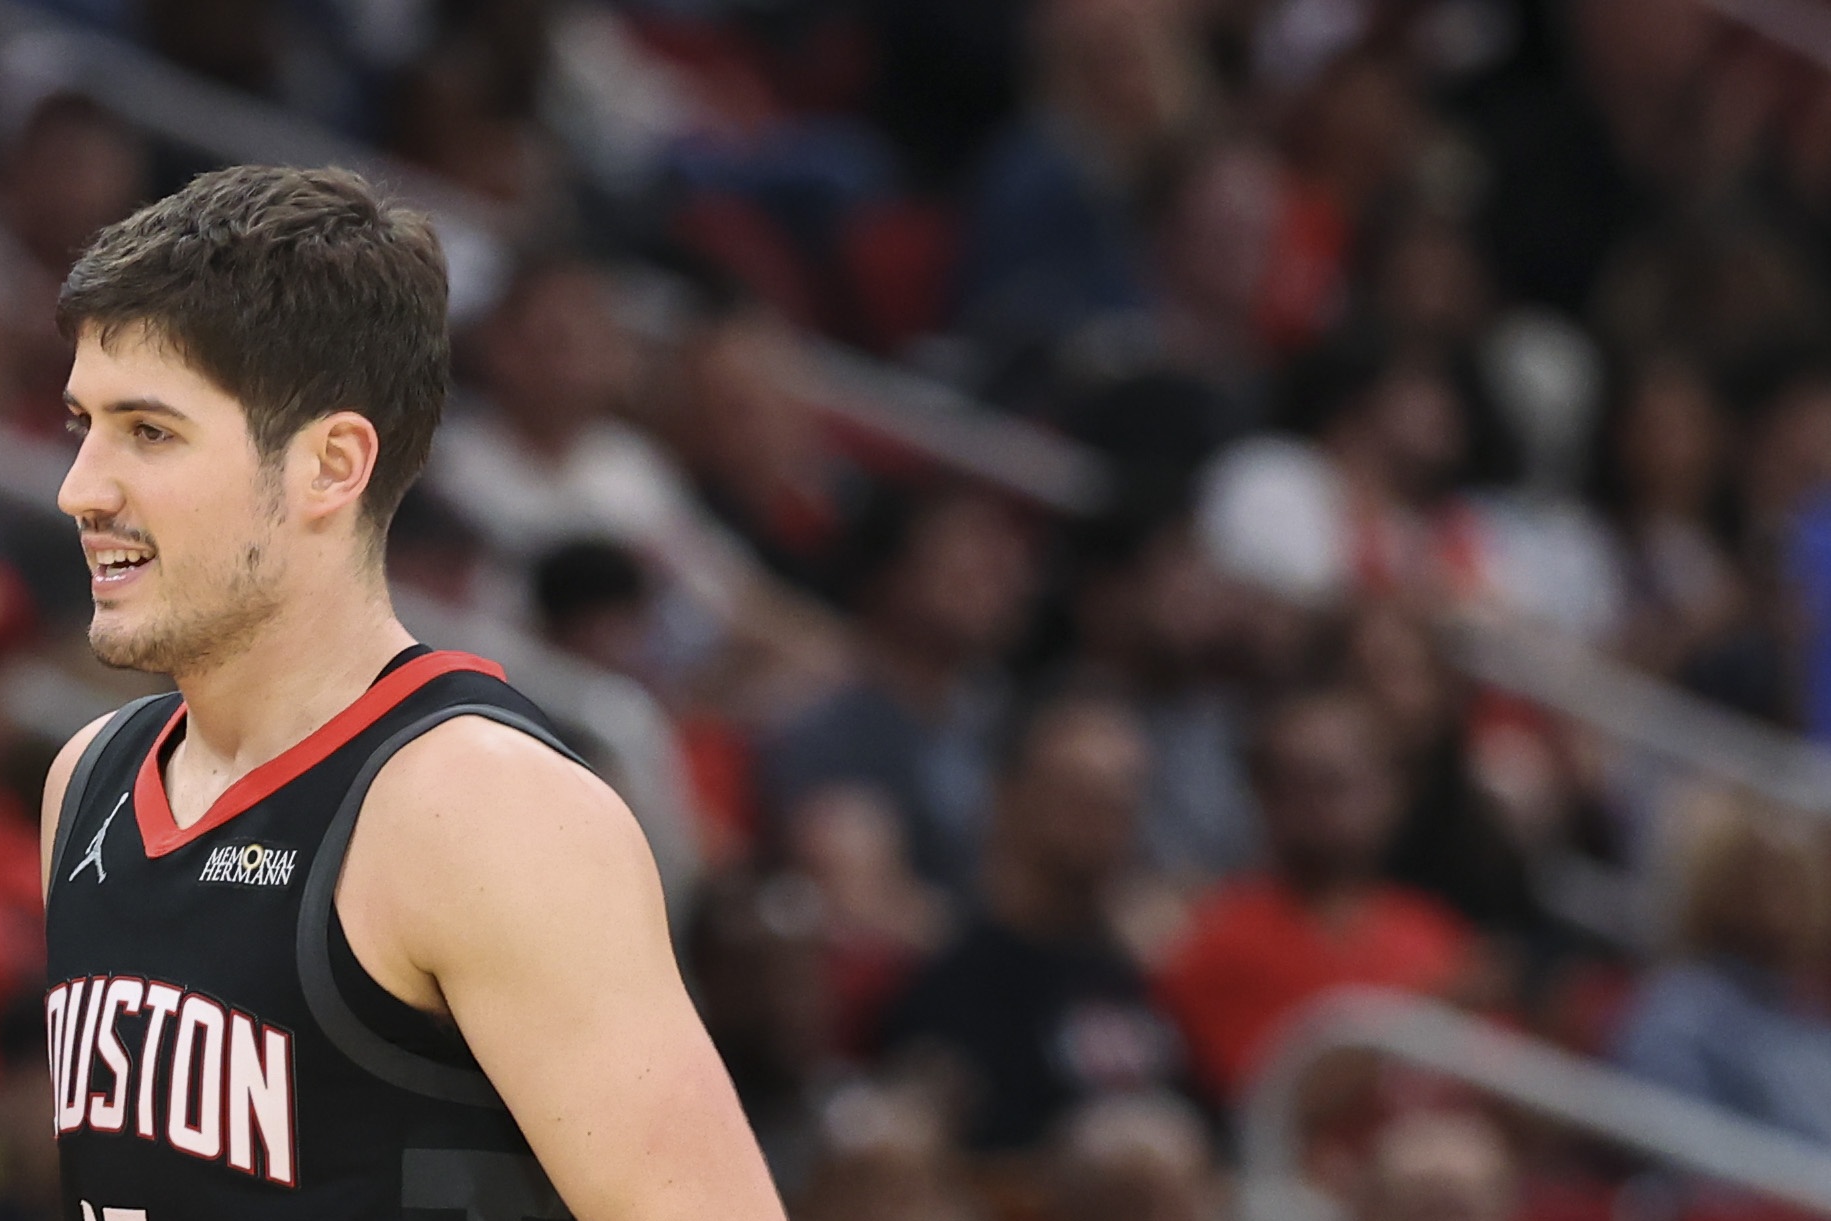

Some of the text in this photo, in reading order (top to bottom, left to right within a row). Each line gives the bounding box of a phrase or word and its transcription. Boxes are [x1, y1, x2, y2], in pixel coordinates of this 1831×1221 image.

[208, 843, 298, 869] MEMORIAL
[199, 861, 294, 886] HERMANN
[44, 975, 296, 1188] OUSTON
